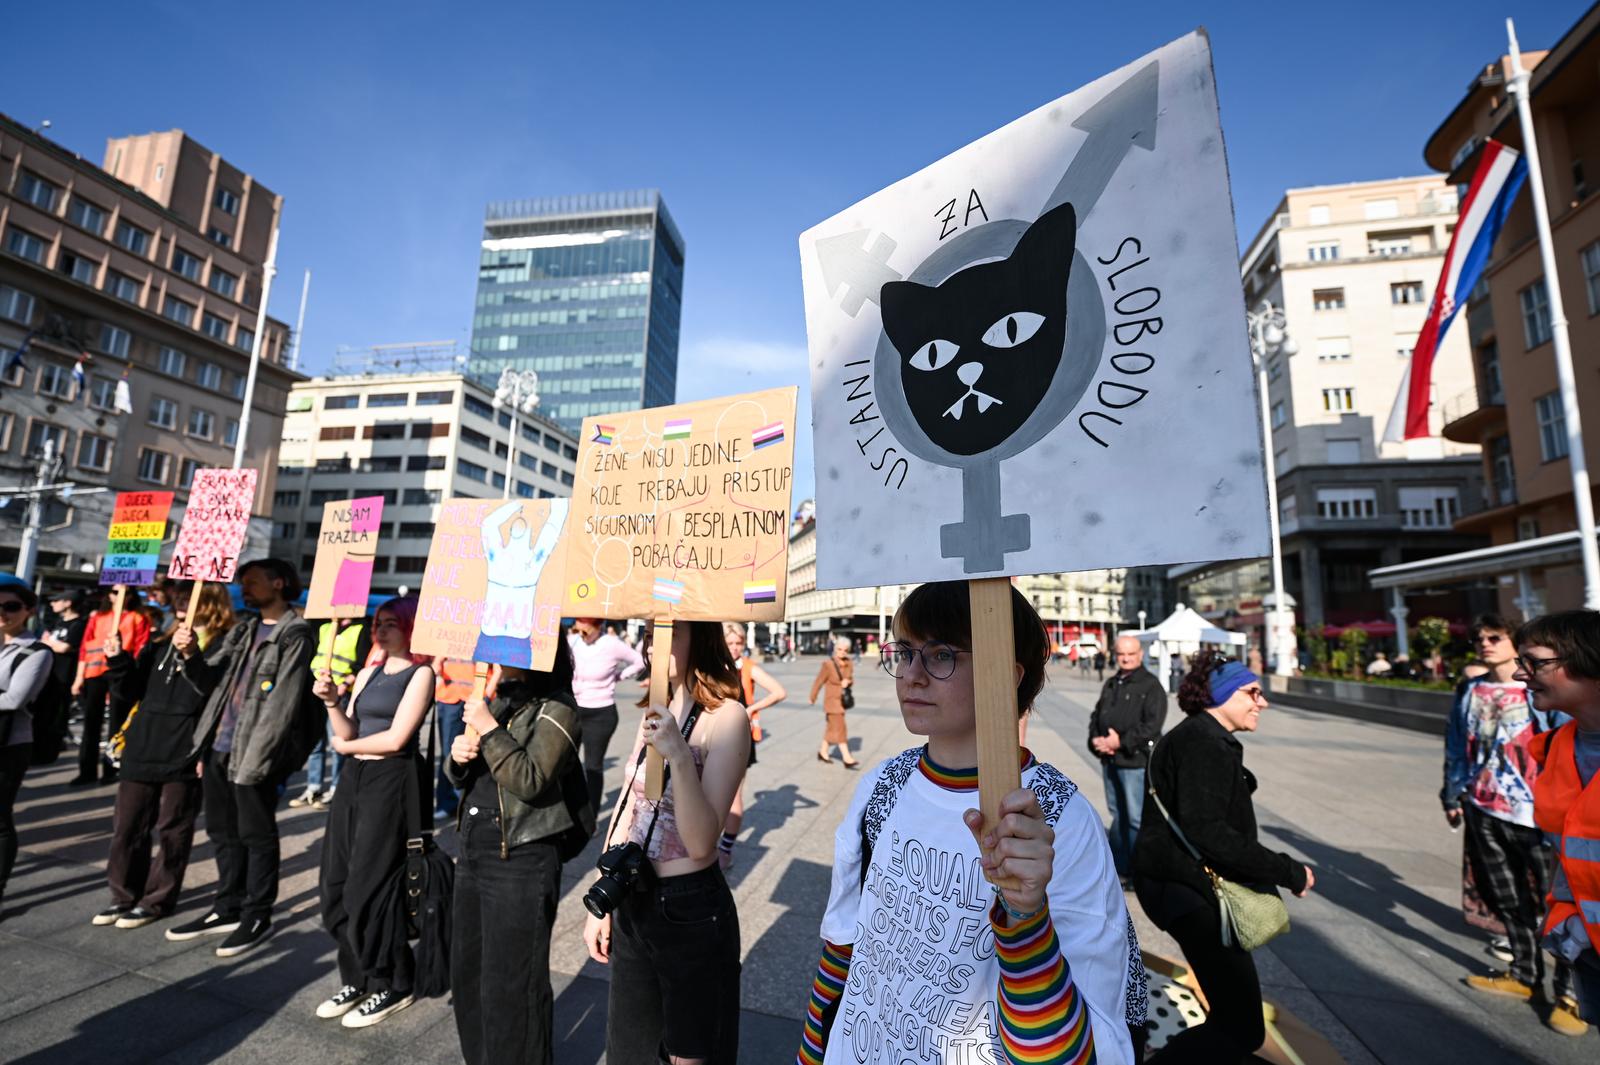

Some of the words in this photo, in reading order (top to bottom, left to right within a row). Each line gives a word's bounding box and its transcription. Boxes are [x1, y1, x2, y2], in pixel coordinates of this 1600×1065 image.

[842, 358, 909, 490] USTANI
[933, 188, 989, 241] ZA
[1078, 237, 1164, 448] SLOBODU
[642, 448, 674, 469] NISU
[684, 438, 742, 468] JEDINE
[124, 495, 153, 507] QUEER
[590, 485, 622, 506] KOJE
[638, 475, 708, 503] TREBAJU
[723, 467, 792, 495] PRISTUP
[332, 507, 371, 523] NISAM
[442, 503, 489, 529] MOJE
[586, 513, 656, 536] SIGURNOM
[667, 513, 672, 536] I
[683, 510, 786, 539] BESPLATNOM
[171, 555, 197, 578] NE
[208, 556, 235, 579] NE
[632, 538, 727, 571] POBAČAJU.
[427, 562, 465, 589] NIJE
[887, 830, 987, 912] EQUAL
[865, 862, 950, 943] IGHTS
[949, 916, 996, 961] FO
[871, 907, 976, 995] OTHERS
[910, 984, 999, 1039] MEA
